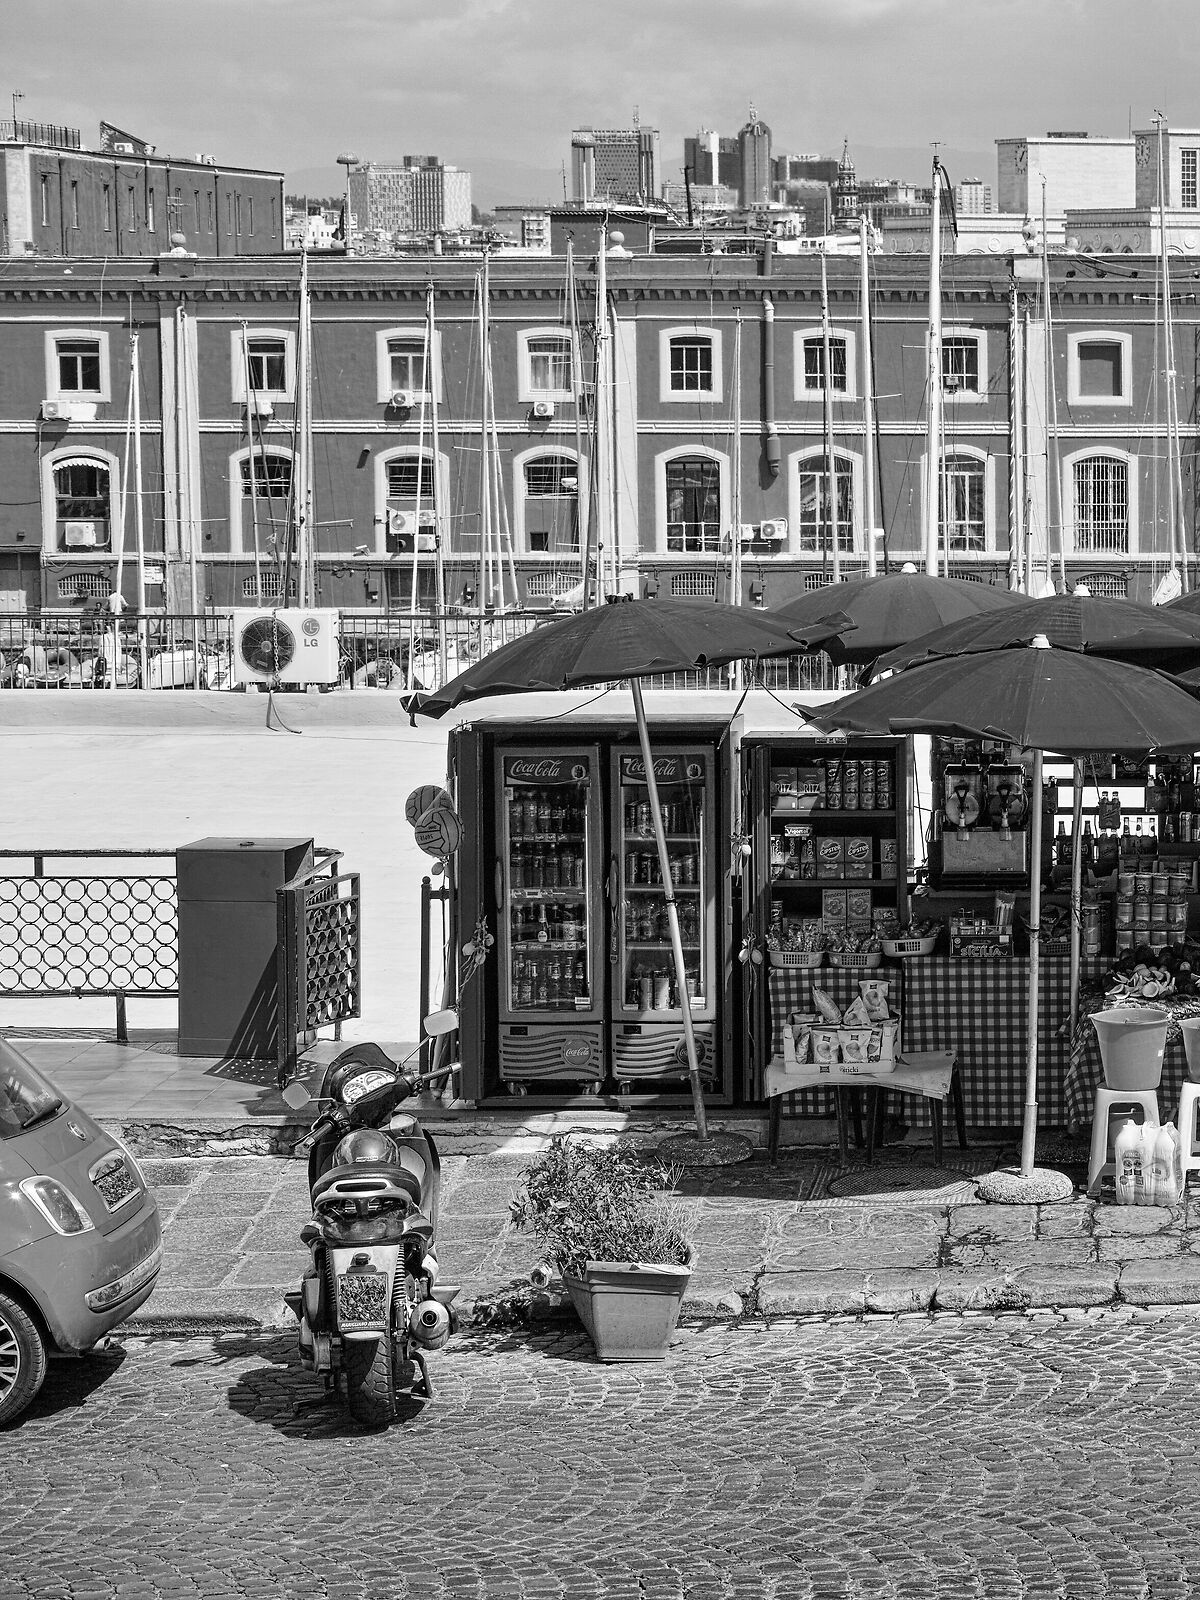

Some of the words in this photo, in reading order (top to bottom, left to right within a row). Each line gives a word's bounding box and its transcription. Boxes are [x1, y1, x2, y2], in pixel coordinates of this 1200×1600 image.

[304, 639, 318, 647] LG
[511, 760, 563, 776] Coca-Cola
[804, 783, 820, 793] RITZ
[566, 1047, 590, 1056] Coca-Cola
